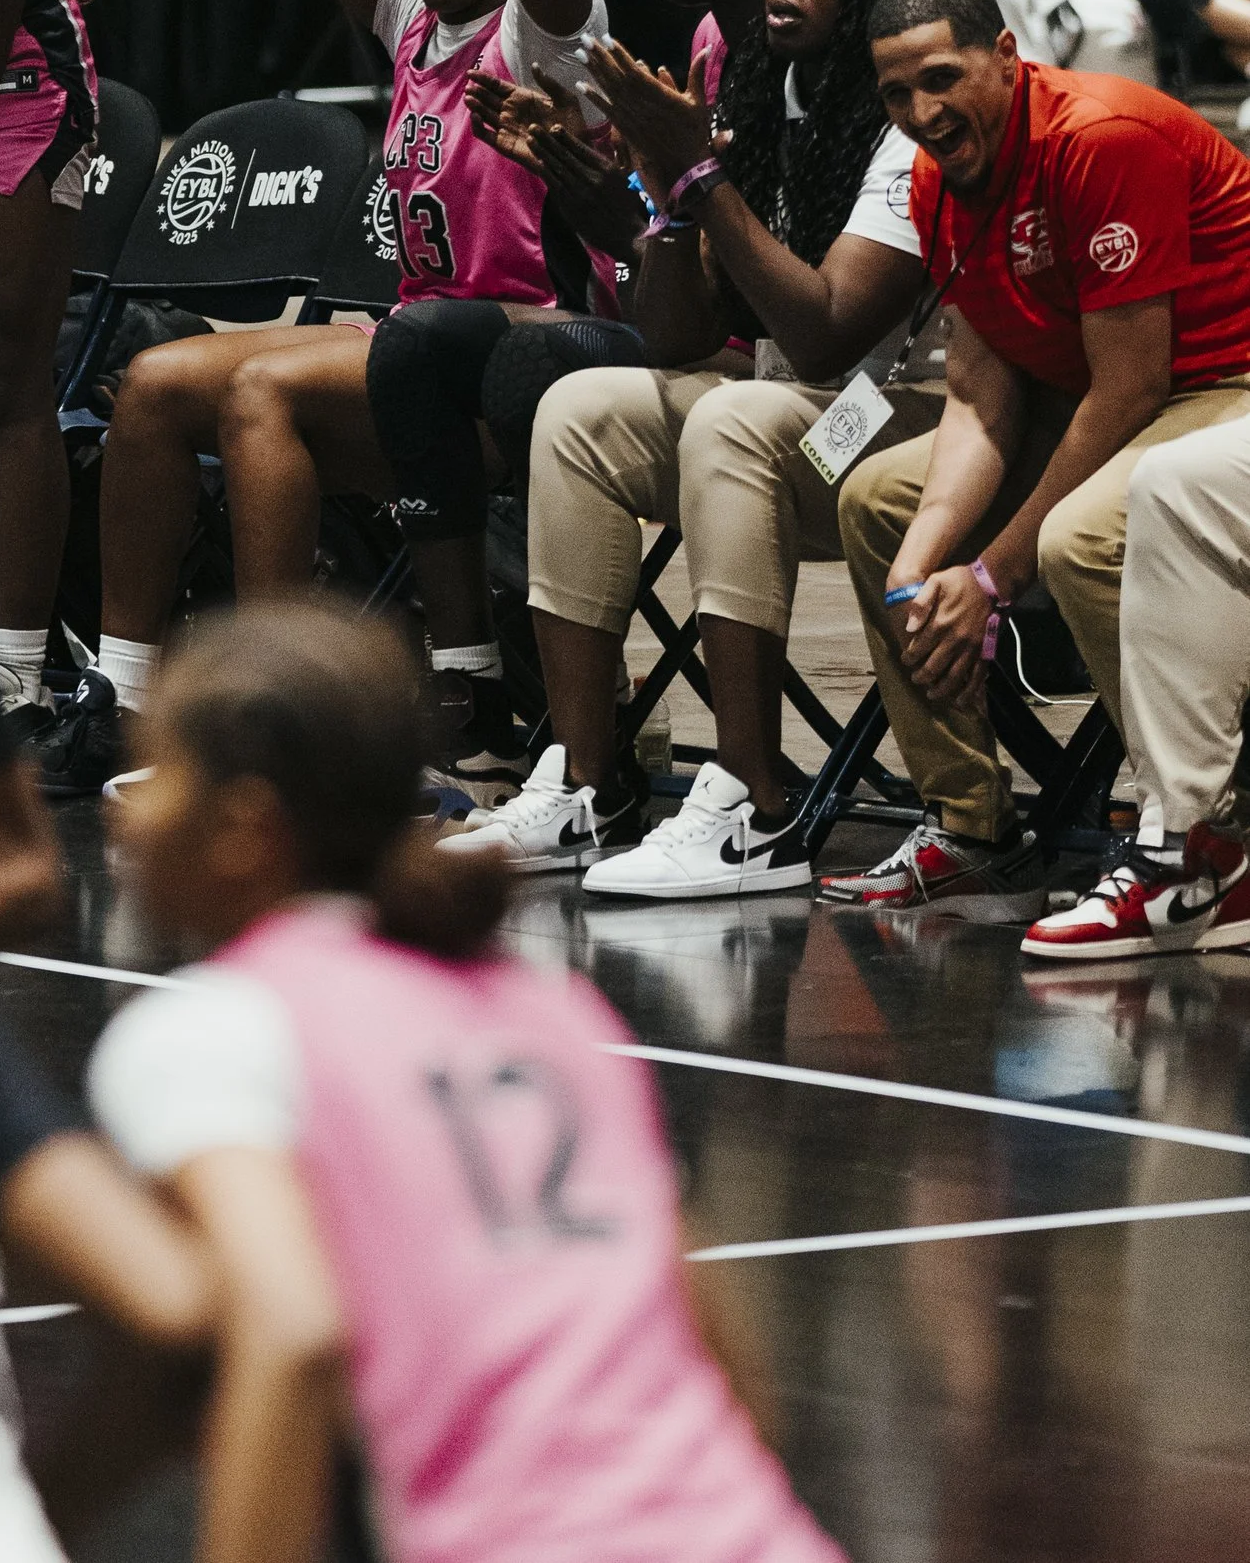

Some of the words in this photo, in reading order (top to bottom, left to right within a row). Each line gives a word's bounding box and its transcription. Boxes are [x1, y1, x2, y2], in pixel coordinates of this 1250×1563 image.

[22, 75, 32, 84] M
[160, 155, 188, 196] NIKE
[190, 140, 237, 194] NATIONALS
[175, 178, 218, 199] EYBL
[248, 165, 323, 207] DICK'S
[366, 173, 388, 205] NIK
[168, 230, 199, 245] 2025
[388, 189, 457, 280] 13
[1095, 235, 1132, 255] EYBL
[375, 244, 398, 261] 202
[836, 414, 857, 440] EYBL
[803, 440, 835, 481] COACH
